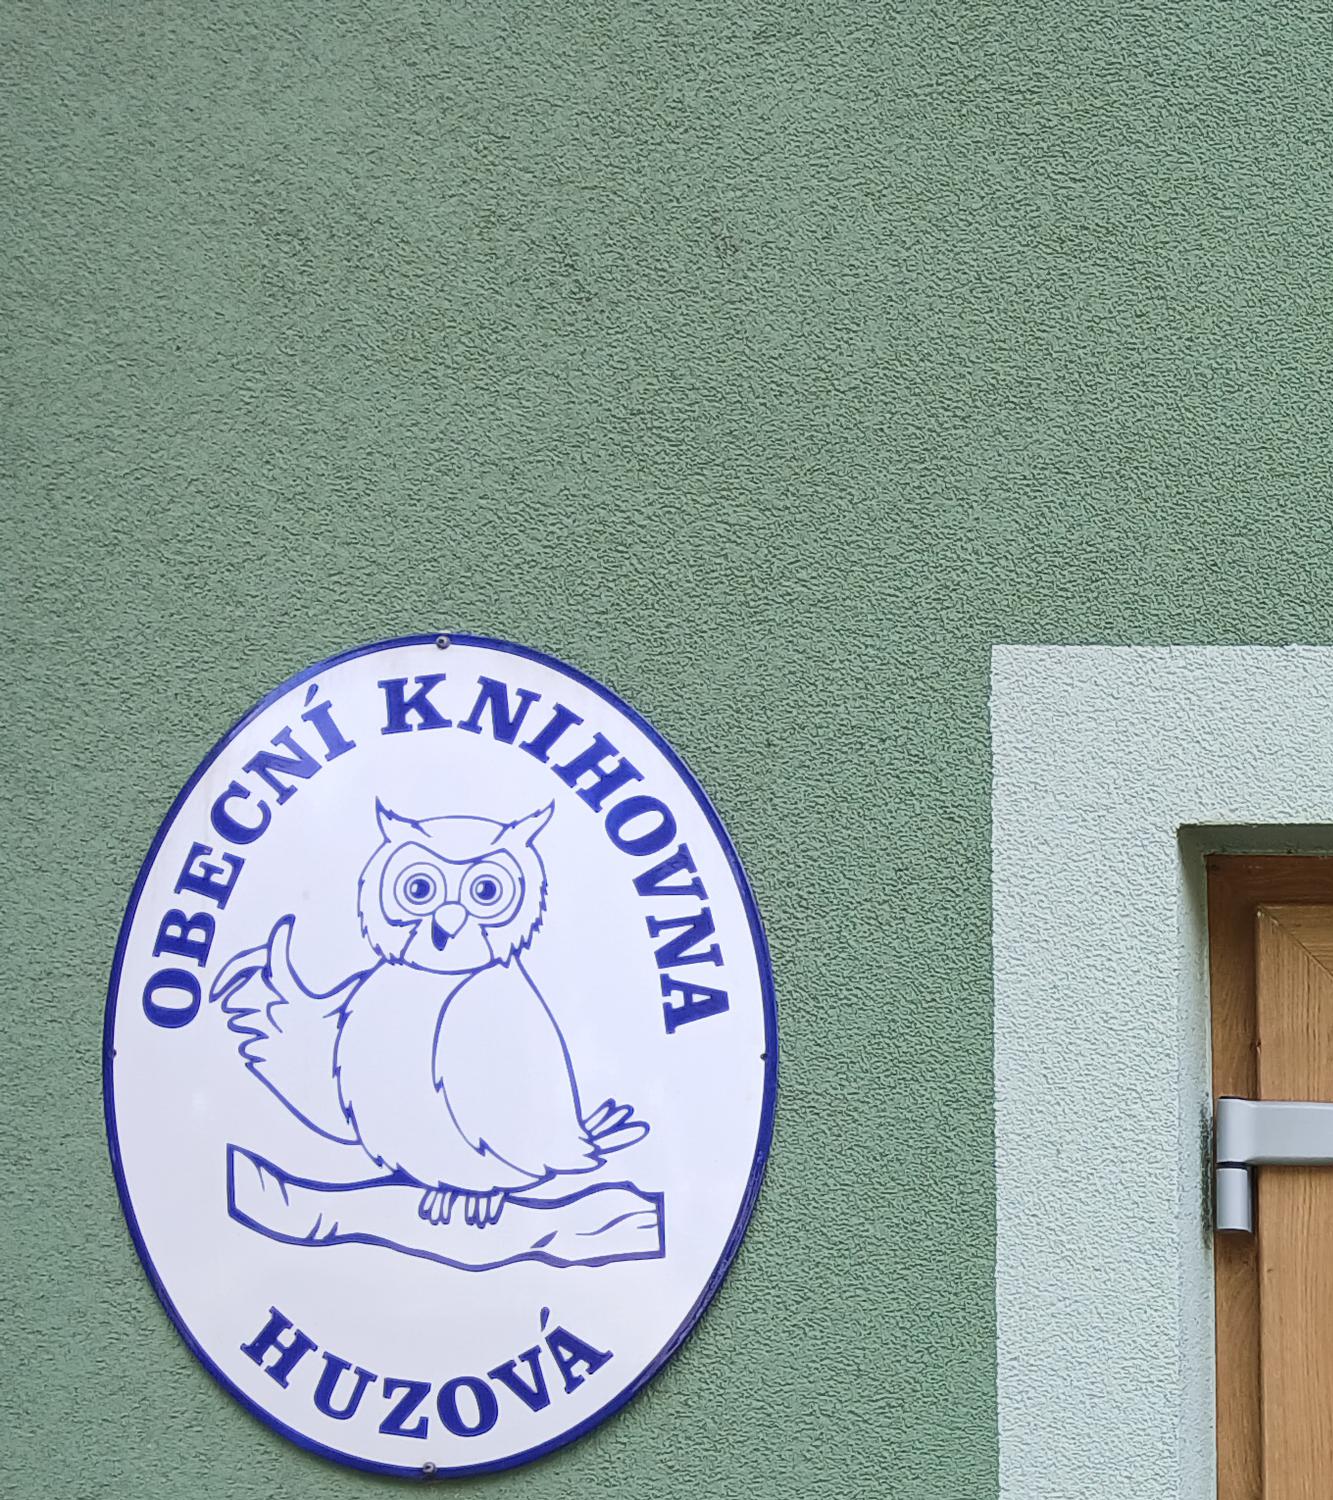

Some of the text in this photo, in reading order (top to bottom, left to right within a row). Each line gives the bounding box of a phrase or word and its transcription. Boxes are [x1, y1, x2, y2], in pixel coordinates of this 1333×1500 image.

[141, 672, 730, 1035] OBECNÍ KNIHOVNA
[239, 1305, 613, 1440] HUZOVÁ
